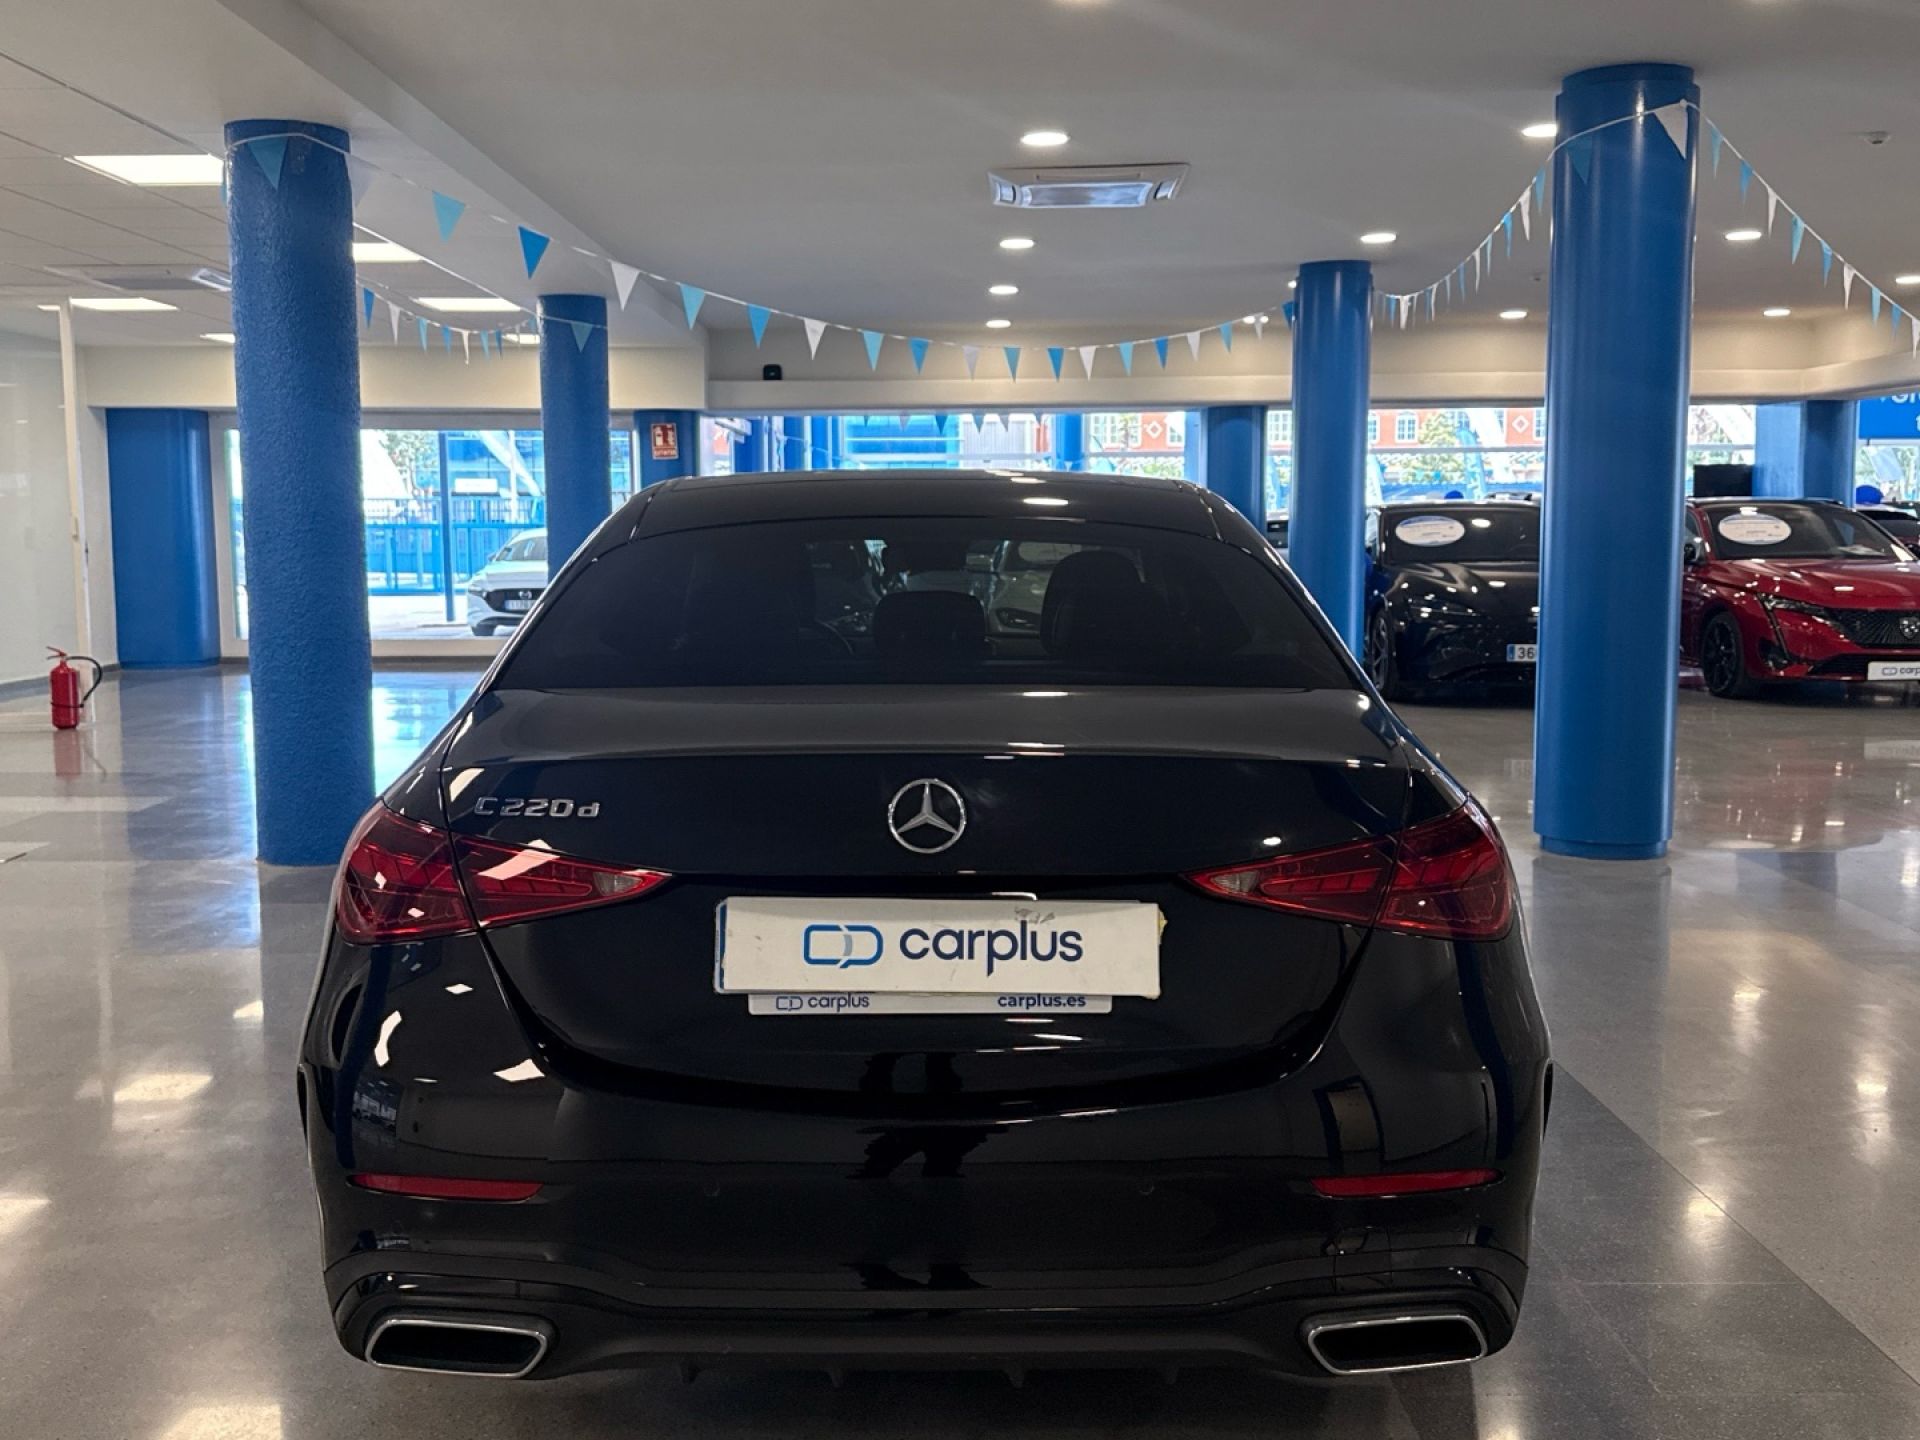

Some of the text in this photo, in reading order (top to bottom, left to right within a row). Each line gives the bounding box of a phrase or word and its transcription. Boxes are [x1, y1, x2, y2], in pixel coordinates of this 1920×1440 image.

[899, 919, 1083, 978] carplus
[808, 991, 870, 1013] carplus
[998, 992, 1087, 1011] carplus.es
